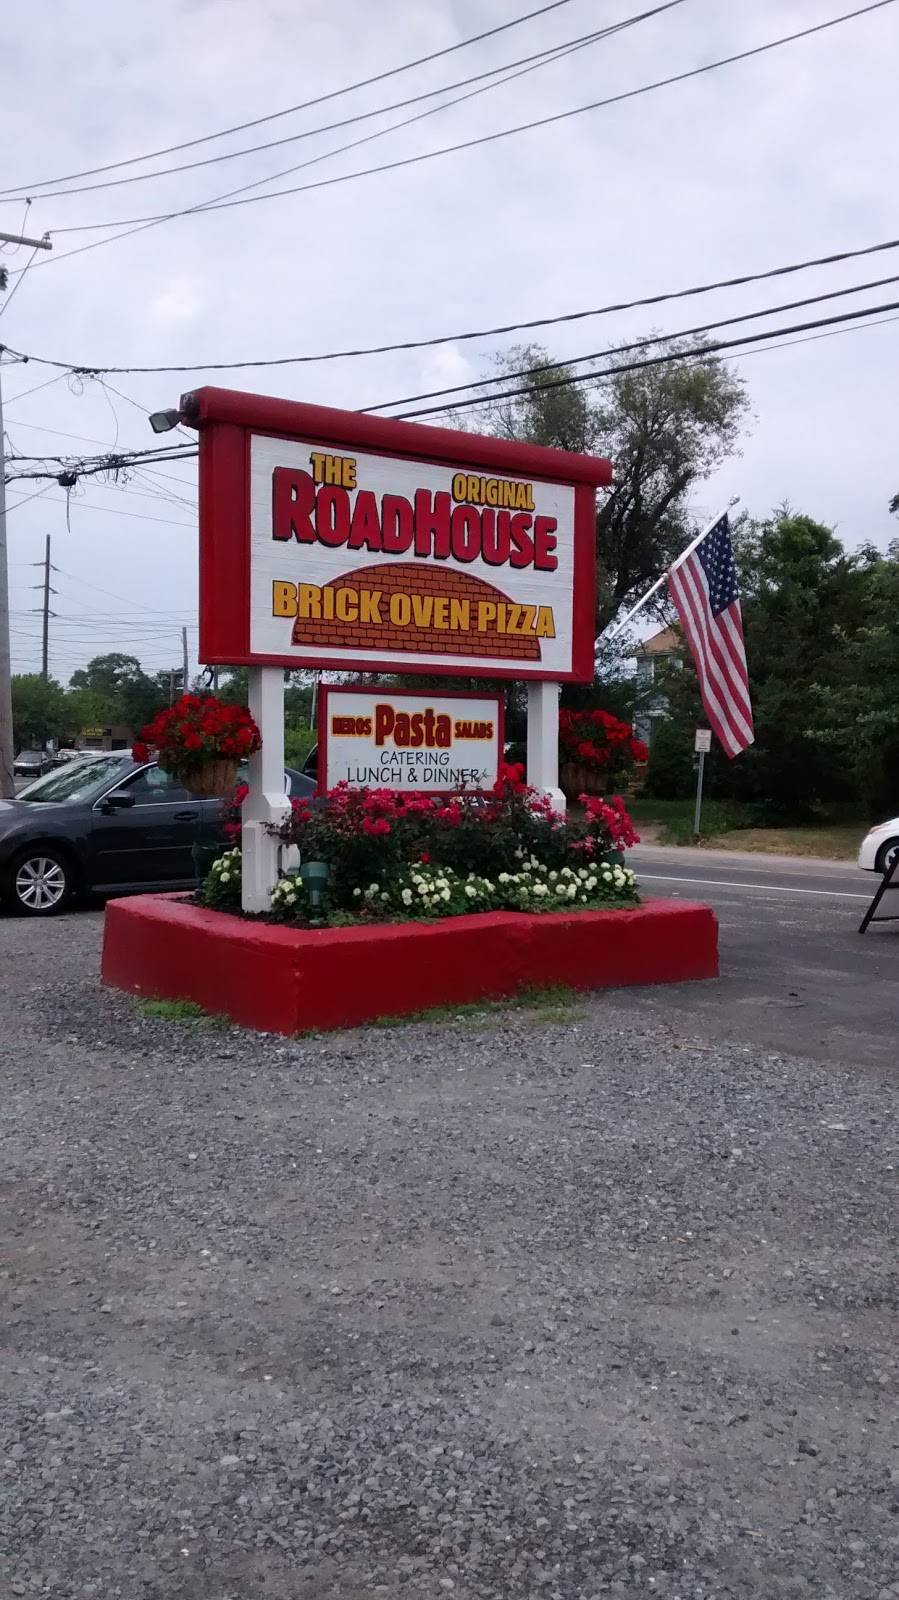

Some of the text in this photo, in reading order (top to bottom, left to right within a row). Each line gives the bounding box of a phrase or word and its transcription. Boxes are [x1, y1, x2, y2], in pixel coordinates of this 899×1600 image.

[311, 452, 357, 490] THE
[452, 473, 535, 511] ORIGINAL
[272, 466, 559, 572] ROADHOUSE
[272, 580, 556, 638] BRICK OVEN PIZZA
[375, 704, 452, 748] Pasta
[454, 721, 493, 739] SALADS
[347, 767, 479, 783] LUNCH & DINNER
[380, 750, 450, 766] CATERING
